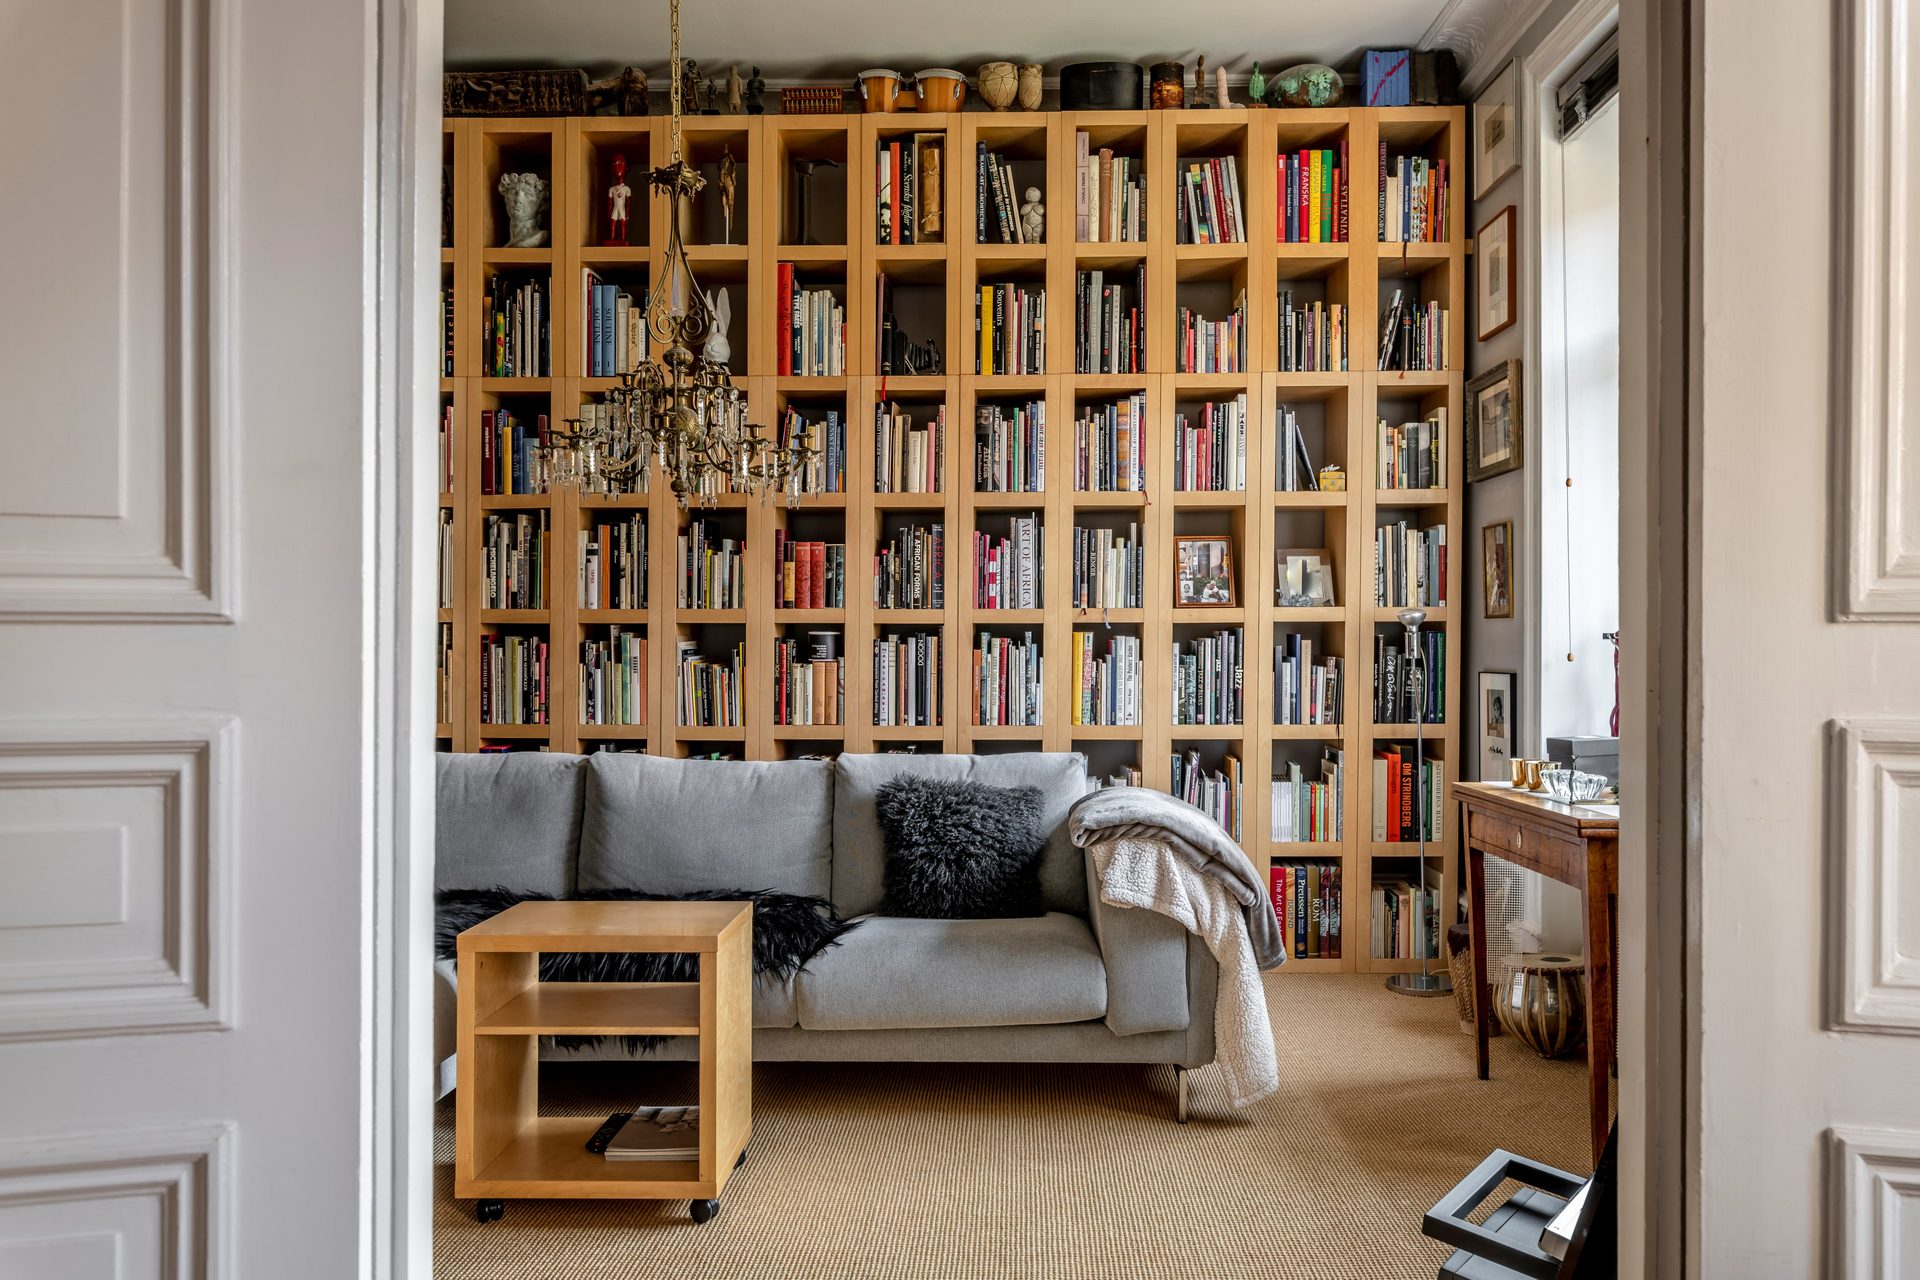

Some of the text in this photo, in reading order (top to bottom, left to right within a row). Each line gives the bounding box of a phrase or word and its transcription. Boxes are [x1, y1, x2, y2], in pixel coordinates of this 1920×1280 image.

[903, 173, 913, 202] Svenska
[1301, 166, 1309, 207] FRANSKA
[1340, 185, 1348, 235] VINATLAS
[446, 288, 454, 357] Baselitz
[593, 307, 601, 345] SOUTINE
[605, 307, 613, 345] SOUTINE
[996, 289, 1005, 327] Souvenirs
[983, 447, 991, 479] Africa
[933, 537, 943, 580] AFRICA
[1021, 521, 1031, 607] ART OF AFRICA
[913, 572, 921, 599] FORMS
[1234, 665, 1243, 690] Jazz
[1401, 762, 1412, 827] OM STRINDBERG
[1275, 879, 1283, 893] The
[1275, 894, 1283, 906] Art
[1297, 879, 1306, 917] Preussen
[1275, 906, 1283, 915] of
[1312, 898, 1321, 922] ROM
